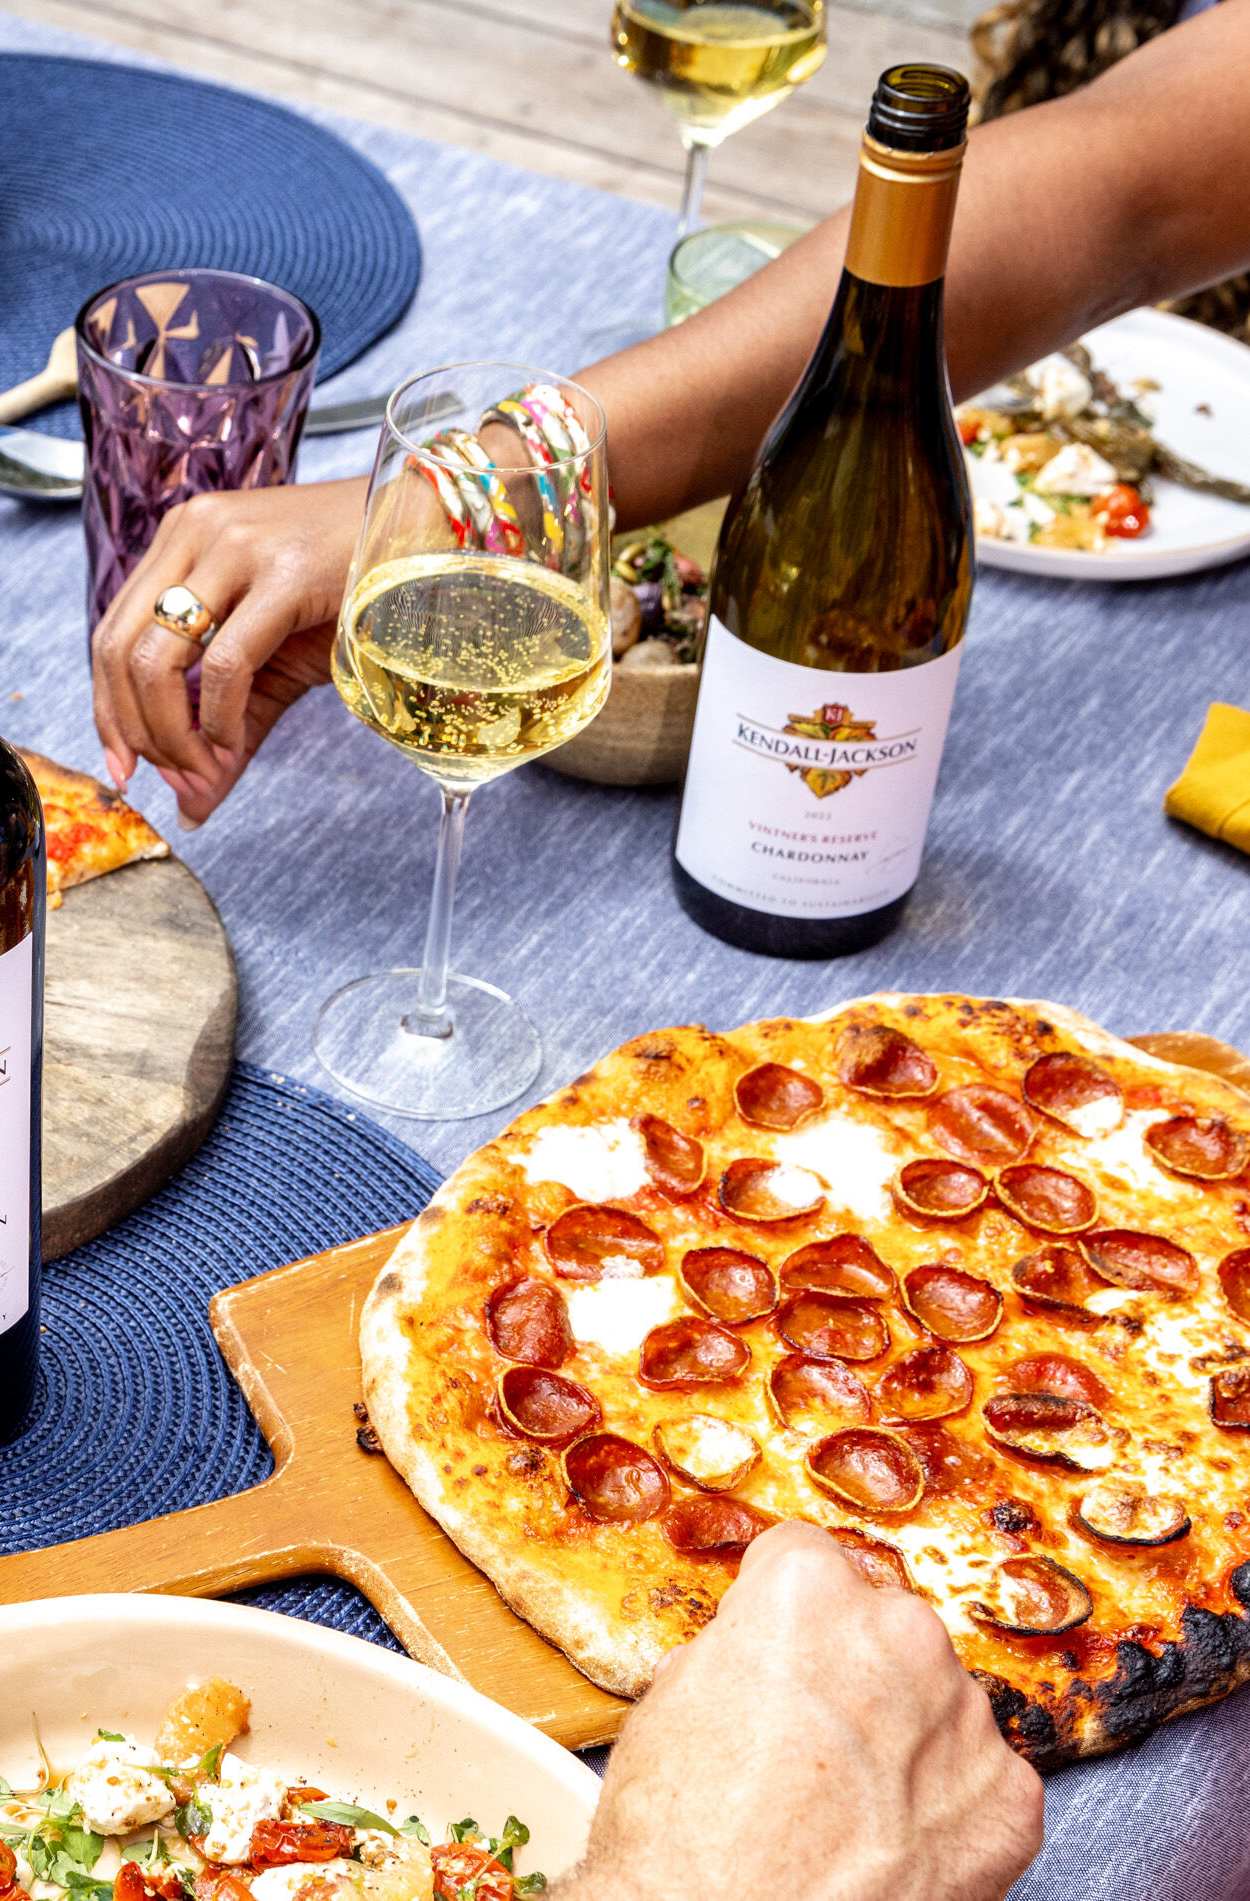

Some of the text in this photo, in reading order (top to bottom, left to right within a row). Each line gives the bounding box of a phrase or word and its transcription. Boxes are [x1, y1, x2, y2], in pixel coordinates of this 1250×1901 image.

[737, 722, 918, 765] KENDALL-JACKSON
[821, 829, 878, 844] RESERVE
[751, 841, 868, 864] CHARDONNAY
